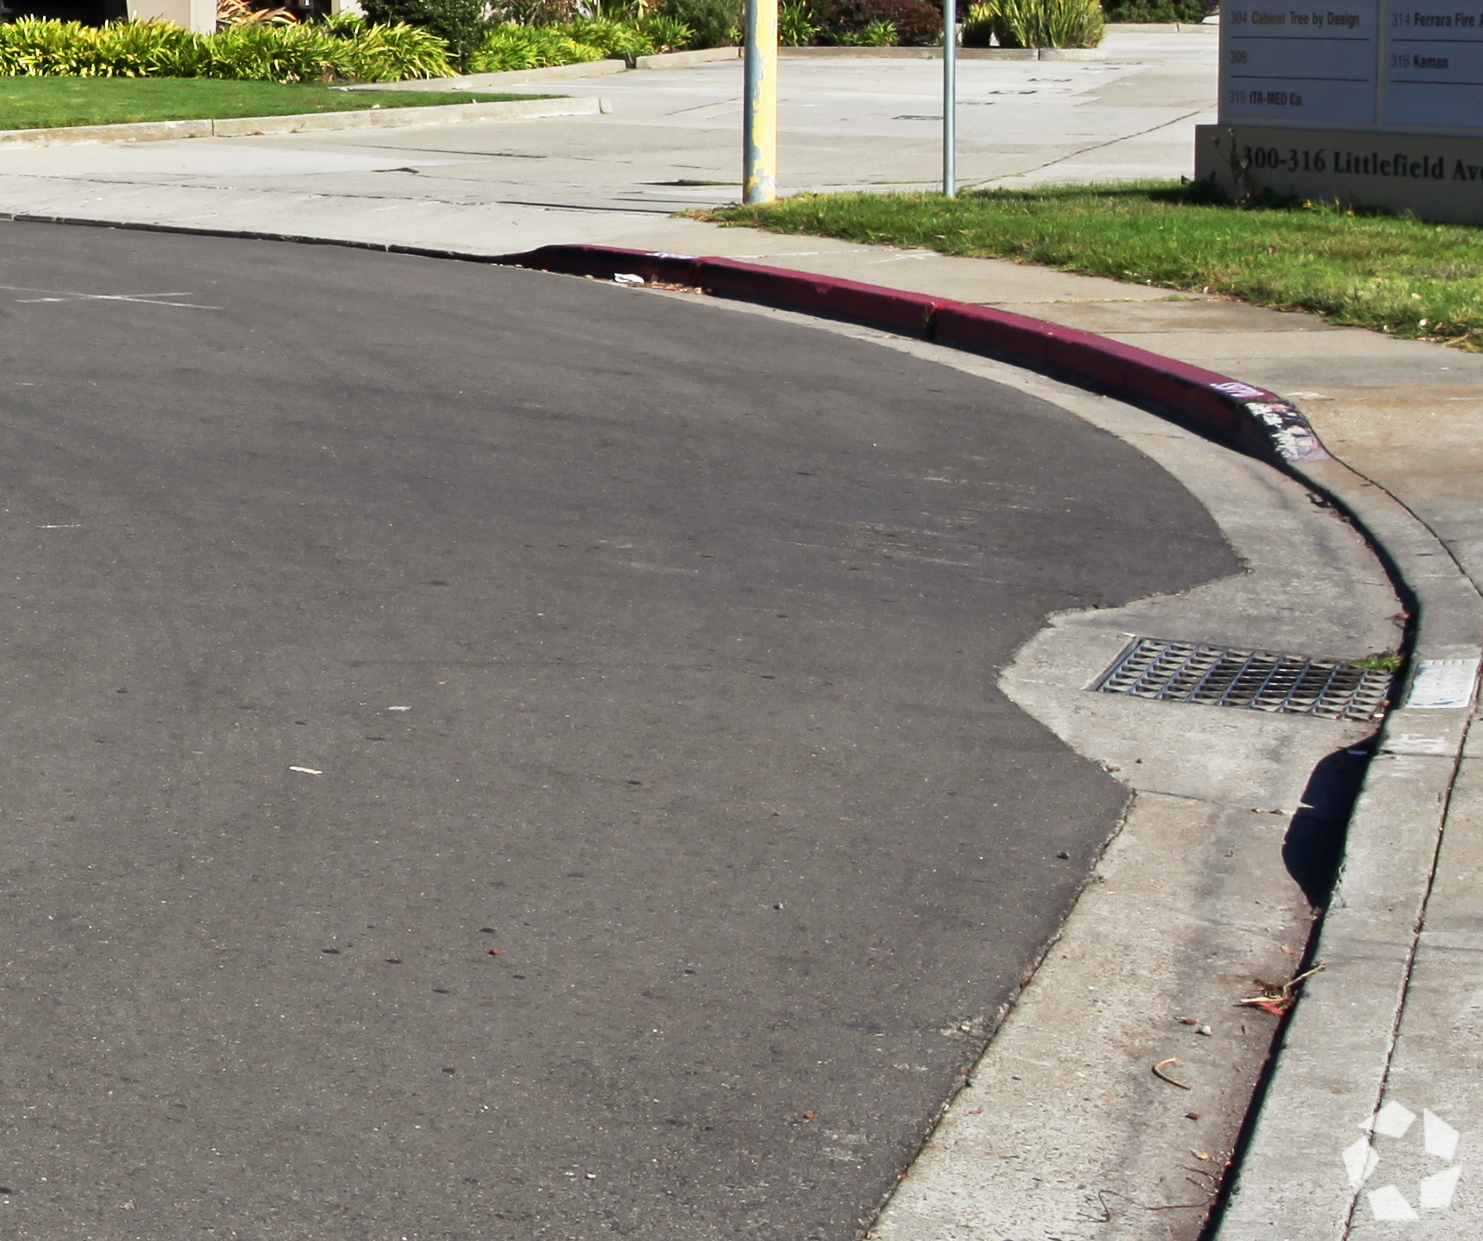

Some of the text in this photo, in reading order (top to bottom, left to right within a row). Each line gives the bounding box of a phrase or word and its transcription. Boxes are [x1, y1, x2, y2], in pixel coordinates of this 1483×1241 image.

[1230, 11, 1247, 24] 304
[1290, 12, 1309, 25] Tree
[1312, 12, 1323, 28] by
[1327, 12, 1360, 29] Design
[1392, 12, 1410, 26] 314
[1414, 12, 1452, 28] Ferrara
[1455, 12, 1475, 28] Fire
[1413, 55, 1448, 69] Kaman
[1228, 91, 1303, 106] 310 ITA-MED Co.
[1243, 146, 1326, 172] 300-316
[1334, 151, 1444, 179] Littlefield
